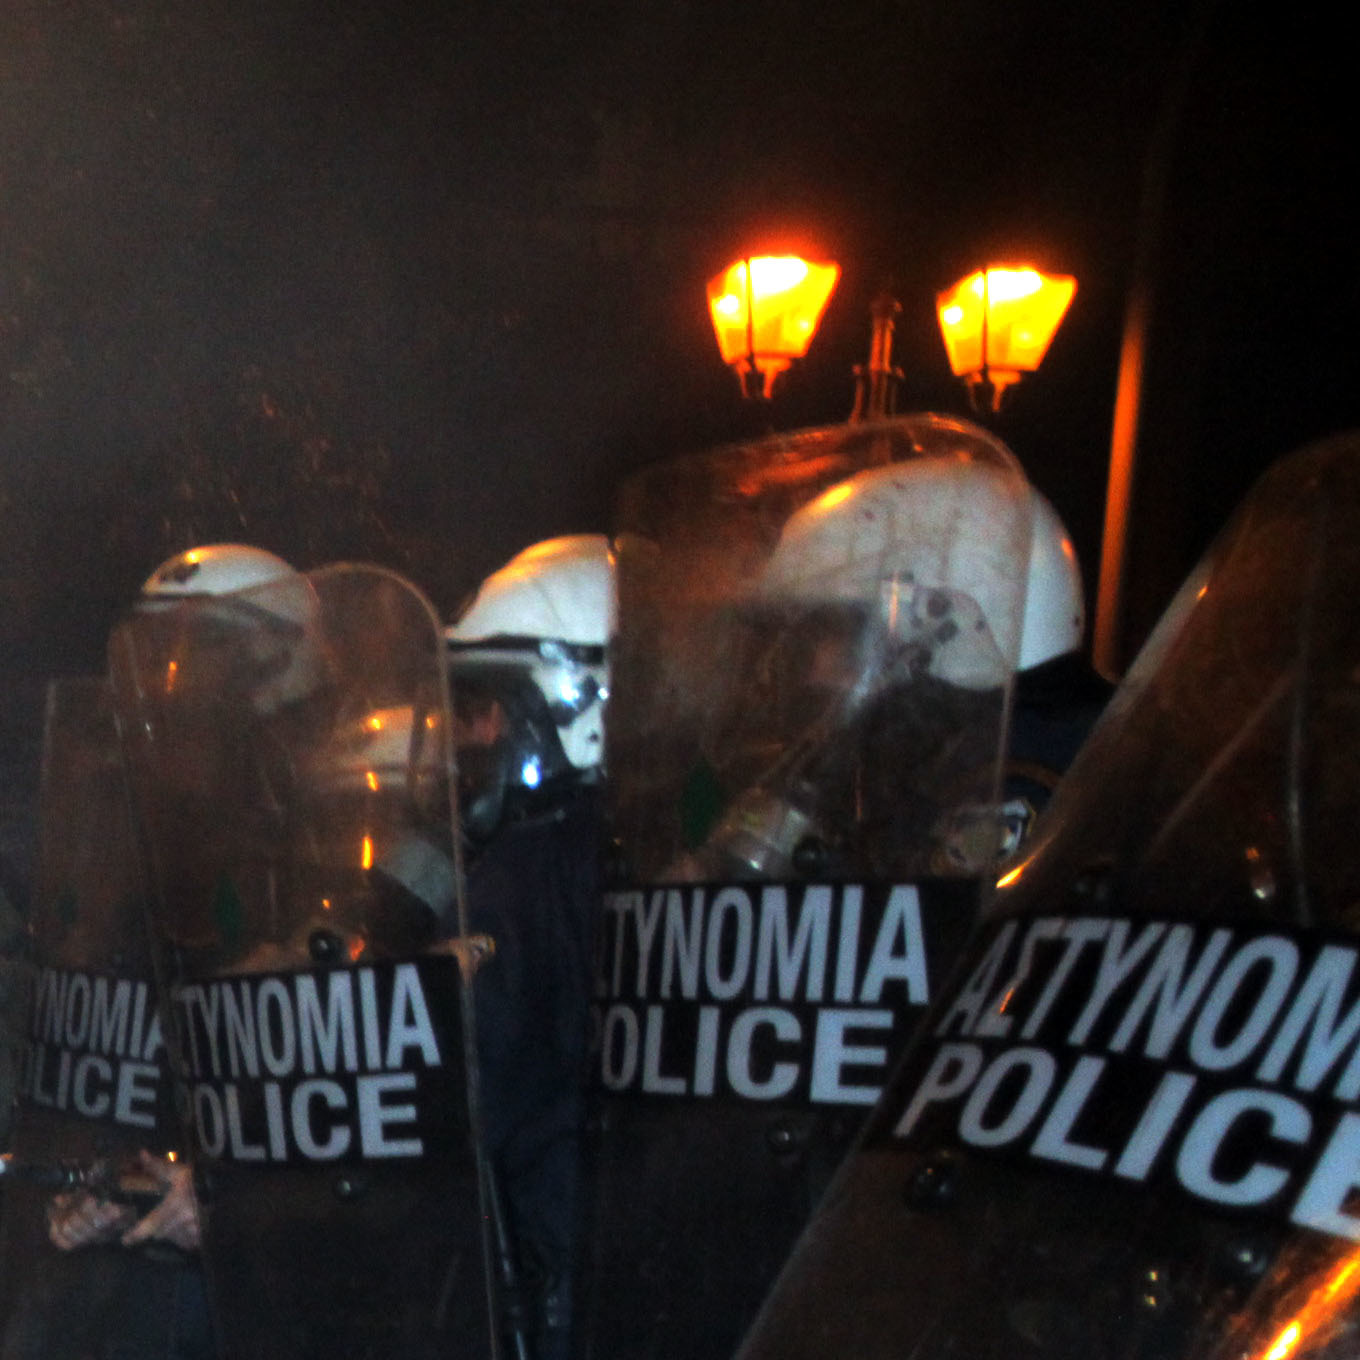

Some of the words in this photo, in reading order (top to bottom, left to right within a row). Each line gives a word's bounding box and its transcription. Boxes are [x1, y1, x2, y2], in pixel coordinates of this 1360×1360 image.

[598, 884, 930, 1006] ΤΥΝΟΜΙΑ
[176, 962, 443, 1079] ΤΥΝΟΜΙΑ
[595, 1003, 895, 1107] OLICE
[935, 916, 1360, 1103] ΑΣΤΥΝΟΜ
[28, 1040, 162, 1129] LICE
[192, 1072, 425, 1161] OLICE
